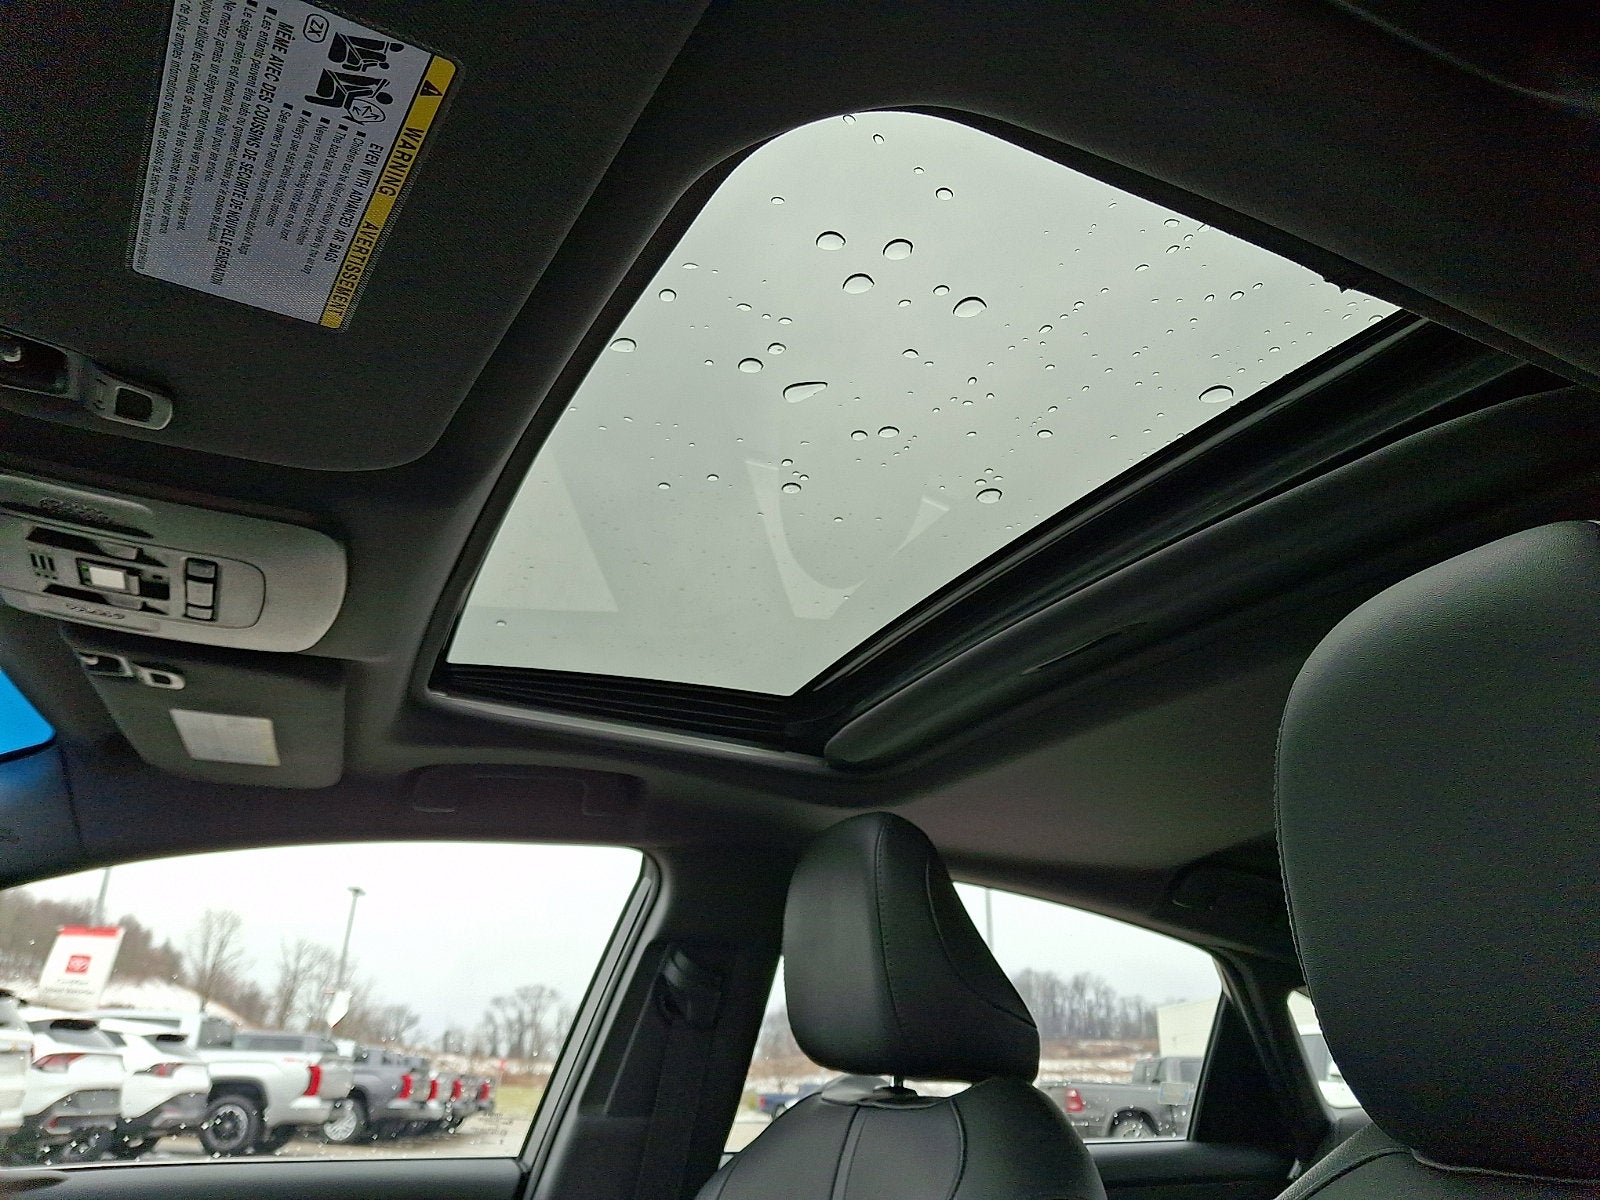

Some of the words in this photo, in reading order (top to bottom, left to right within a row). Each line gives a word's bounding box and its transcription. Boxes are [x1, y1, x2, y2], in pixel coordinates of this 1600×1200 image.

[179, 3, 191, 14] de
[222, 0, 236, 11] Ne
[242, 6, 256, 18] Le
[175, 13, 190, 32] plus
[216, 11, 231, 38] mettez
[235, 18, 252, 40] siège
[260, 14, 275, 30] Les
[307, 18, 324, 37] ZX
[170, 32, 185, 59] amples
[194, 25, 208, 51] utiliser
[253, 30, 269, 58] enfants
[271, 21, 295, 54] MÊME
[191, 50, 205, 62] les
[211, 36, 227, 63] jamais
[231, 40, 246, 64] arrière
[209, 63, 219, 73] un
[228, 65, 239, 78] est
[245, 56, 261, 87] peuvent
[264, 53, 284, 82] AVEC
[164, 59, 182, 101] informations
[185, 62, 201, 95] ceintures
[203, 73, 219, 93] siège
[183, 94, 195, 104] de
[201, 91, 213, 109] pour
[221, 77, 238, 105] l'endroit
[242, 87, 256, 101] être
[258, 81, 276, 103] DES
[162, 101, 172, 111] au
[238, 101, 251, 116] tués
[277, 109, 291, 123] See
[197, 109, 210, 130] enfant
[216, 110, 230, 126] plus
[236, 116, 246, 126] ou
[245, 103, 270, 148] COUSSINS
[291, 116, 309, 140] Always
[270, 123, 285, 148] owner's
[313, 123, 328, 143] Never
[332, 131, 346, 143] The
[242, 147, 258, 161] DE
[289, 139, 300, 151] use
[308, 142, 319, 155] put
[345, 137, 364, 162] Children
[362, 142, 383, 167] EVEN
[284, 151, 296, 166] seat
[377, 126, 424, 196] WARNING
[231, 161, 256, 200] SÉCURITÉ
[353, 168, 373, 189] WITH
[229, 198, 243, 210] DE
[338, 188, 363, 227] ADVANCED
[219, 209, 241, 246] NOUVELLE
[331, 228, 347, 242] AIR
[323, 242, 342, 263] BAGS
[327, 220, 379, 316] AVERTISSEMENT
